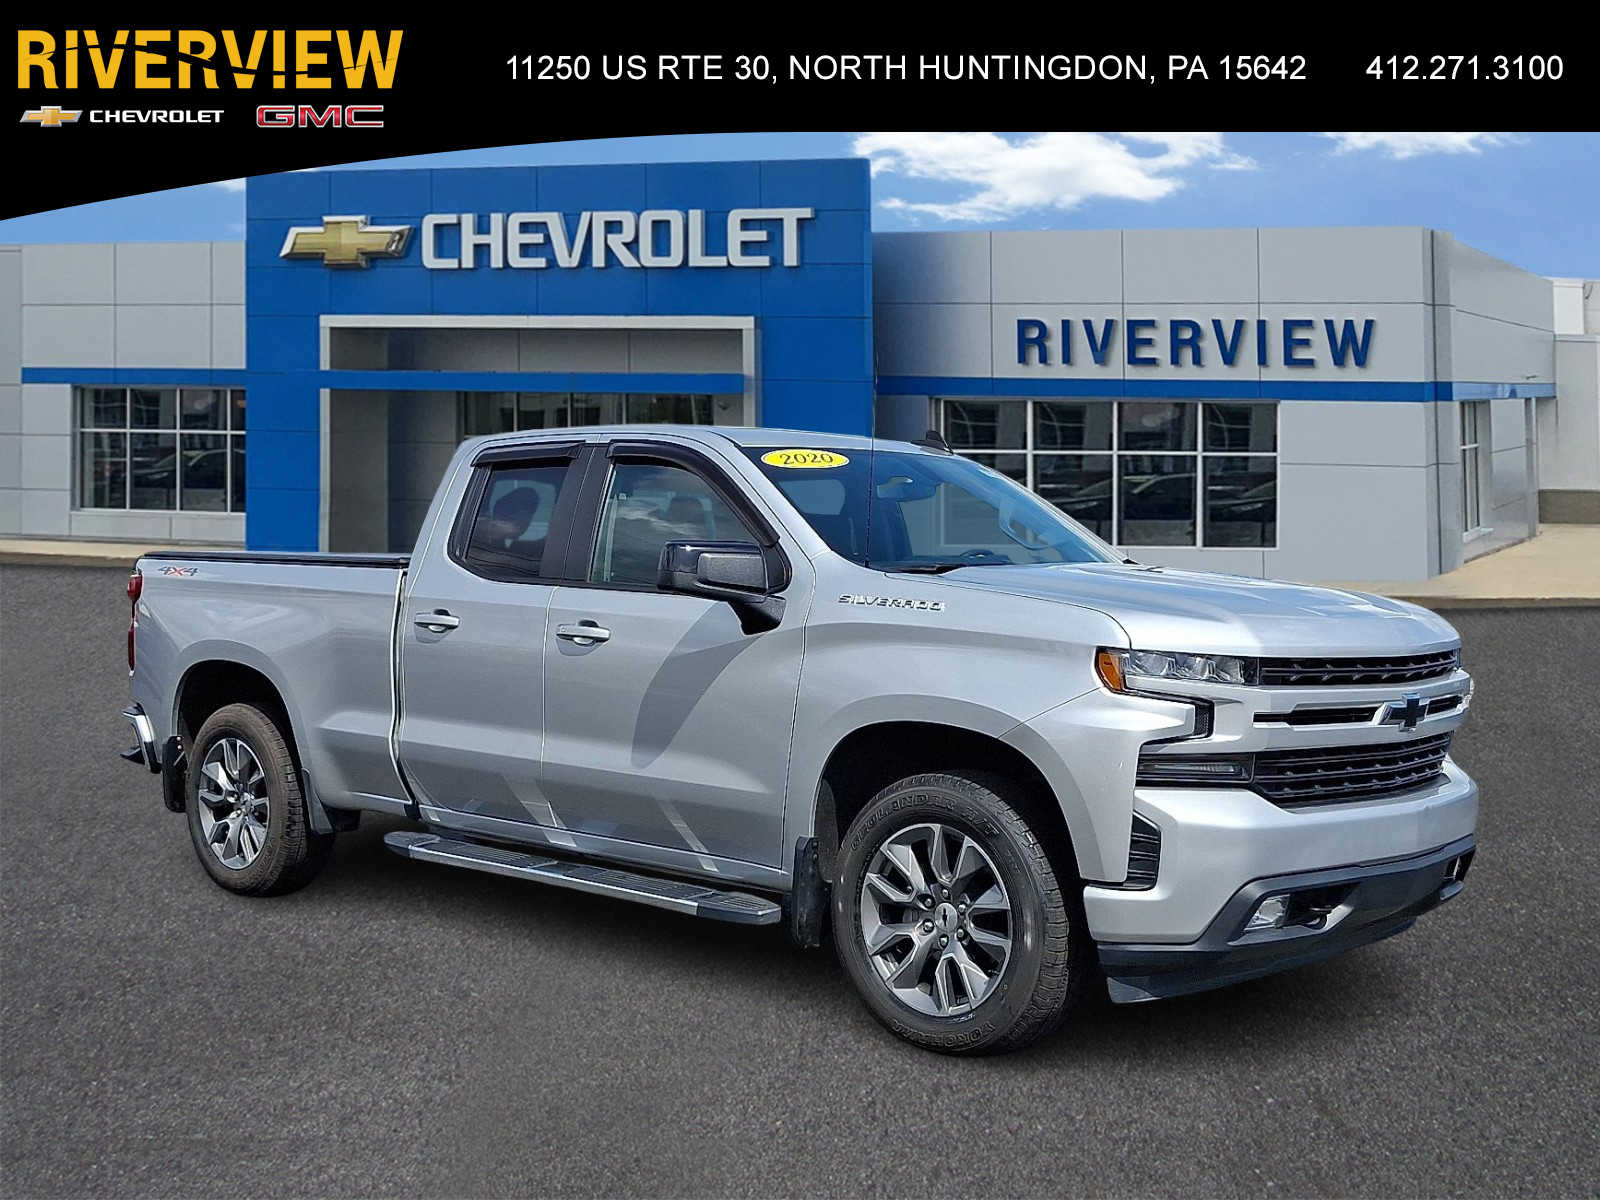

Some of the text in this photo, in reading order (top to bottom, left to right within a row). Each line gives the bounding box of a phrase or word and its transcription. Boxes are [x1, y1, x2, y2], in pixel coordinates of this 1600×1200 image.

[421, 207, 813, 270] CHEVROLET
[1016, 316, 1377, 368] RIVERVIEW
[779, 452, 833, 466] 2020
[838, 593, 945, 613] SILVERADO
